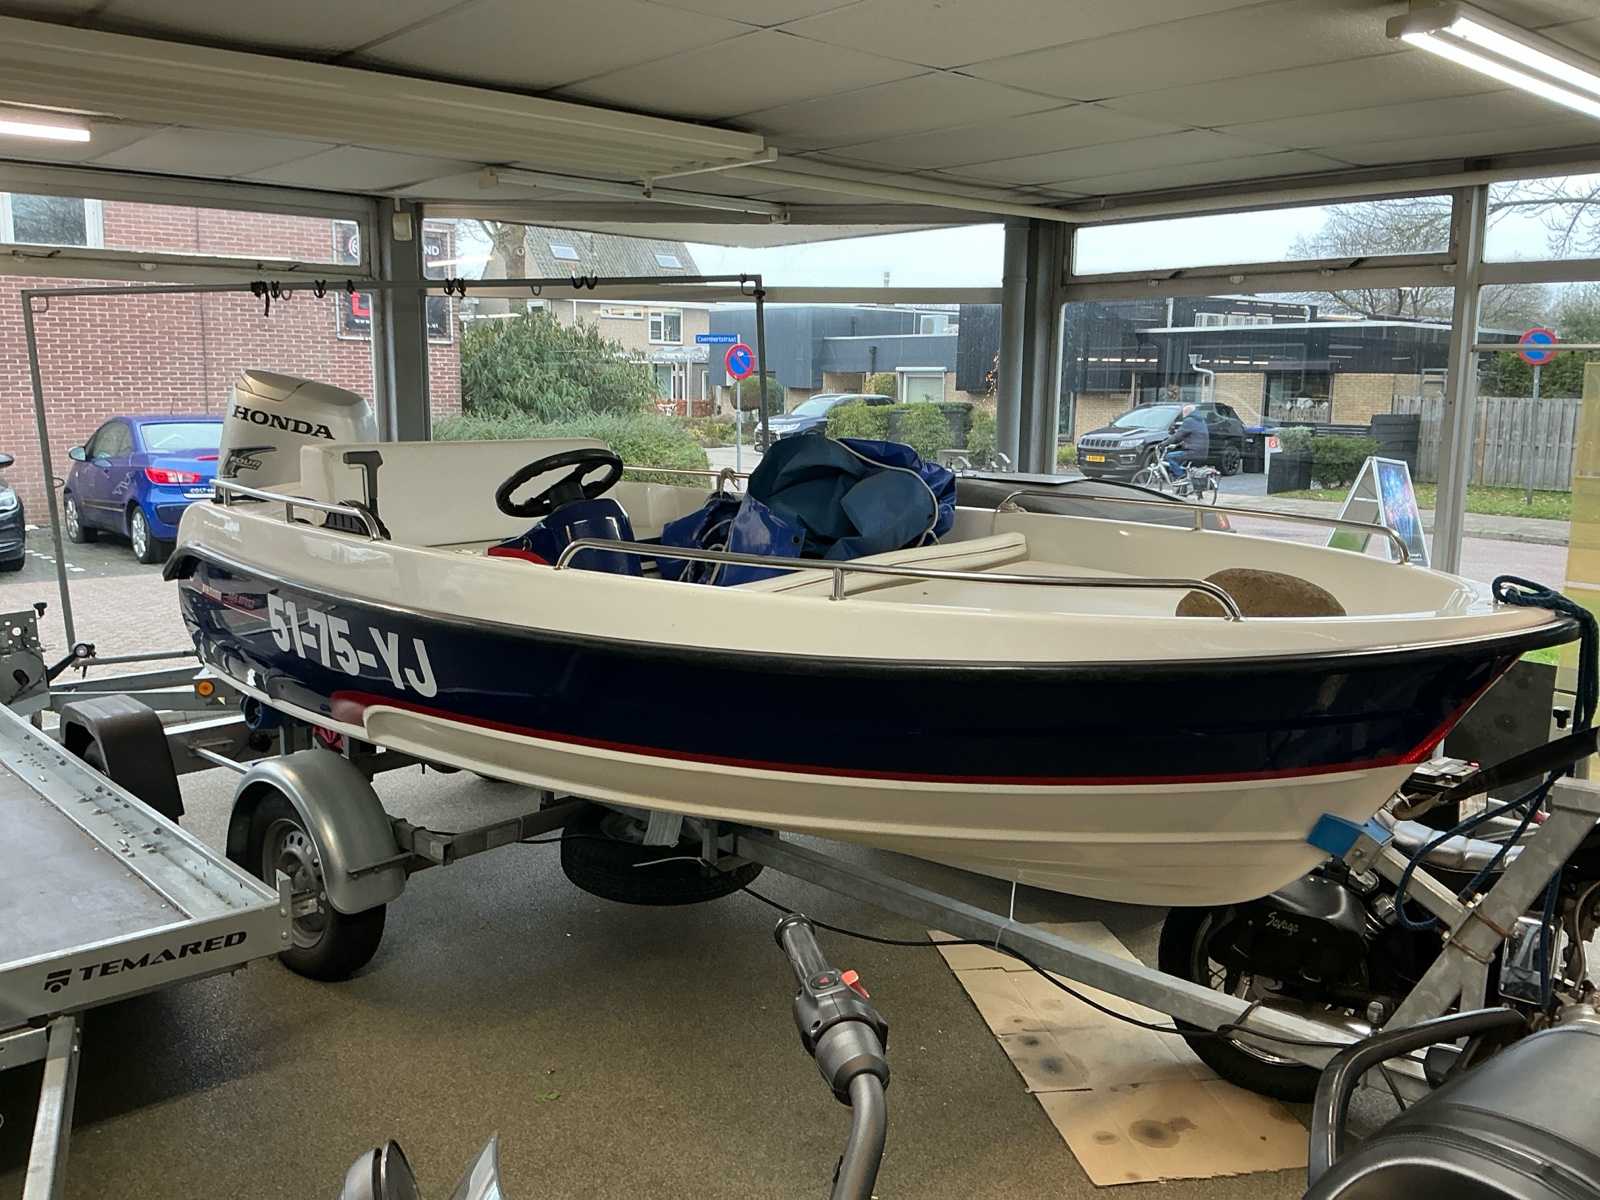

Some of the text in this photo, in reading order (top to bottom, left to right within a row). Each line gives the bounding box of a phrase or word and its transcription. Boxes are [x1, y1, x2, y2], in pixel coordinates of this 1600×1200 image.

[232, 405, 336, 440] HONDA
[267, 593, 438, 698] 51-75-YJ
[79, 931, 248, 981] TEMARED
